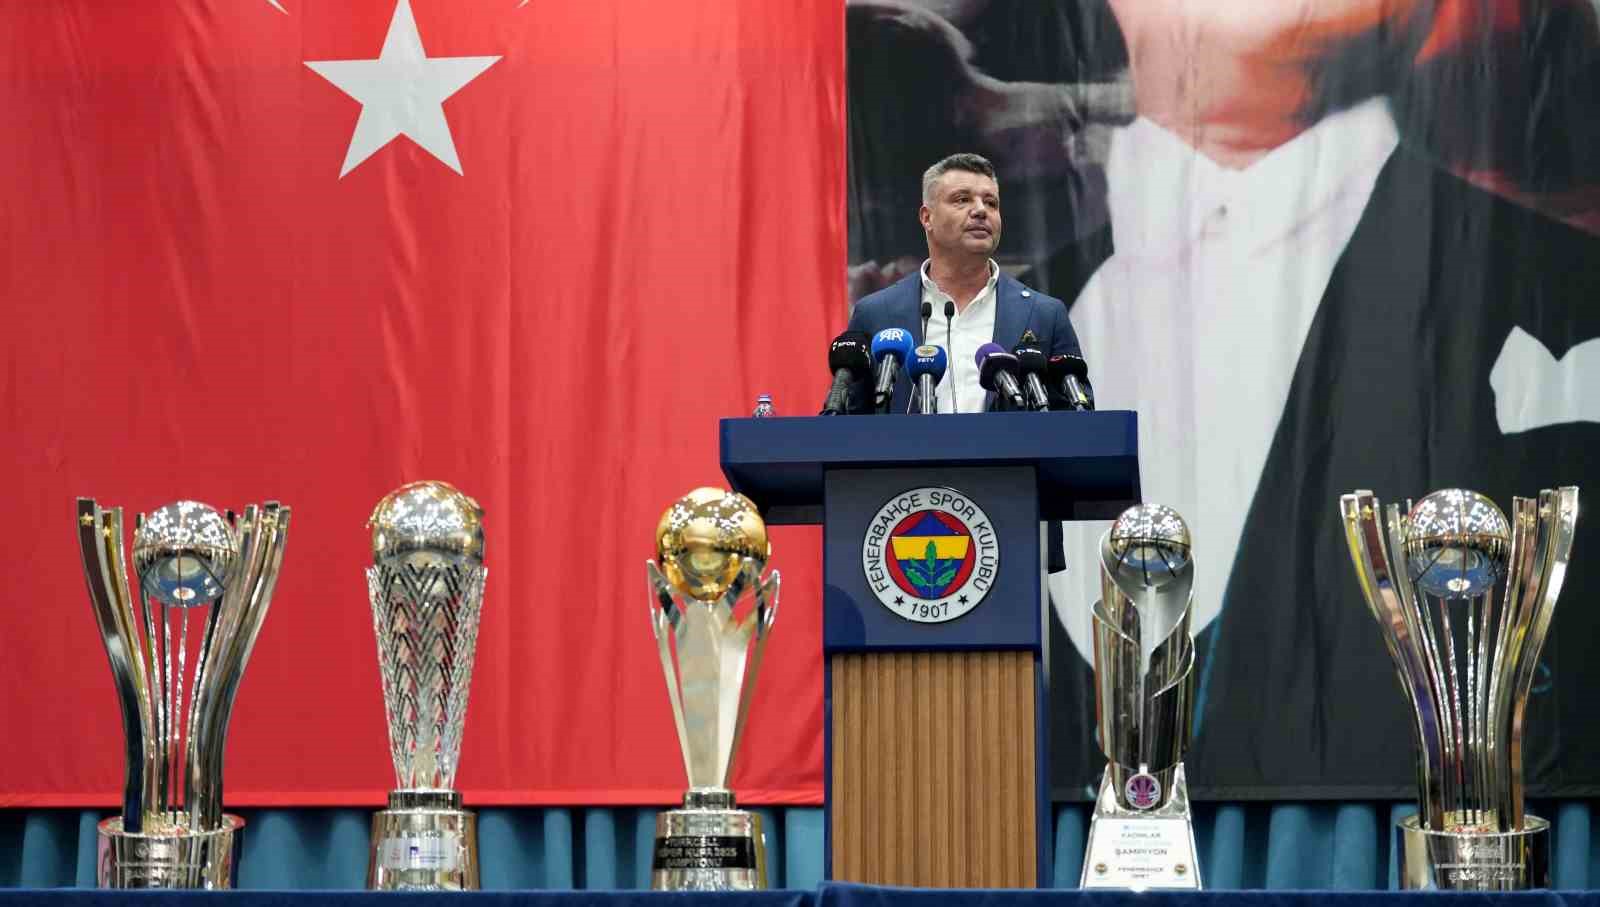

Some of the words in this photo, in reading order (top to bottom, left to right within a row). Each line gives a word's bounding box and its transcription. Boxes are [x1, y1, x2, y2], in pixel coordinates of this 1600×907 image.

[867, 493, 922, 593] FENERBAHÇE
[929, 491, 976, 521] SPOR
[973, 521, 998, 592] KULÜBÜ
[911, 602, 949, 618] 1907
